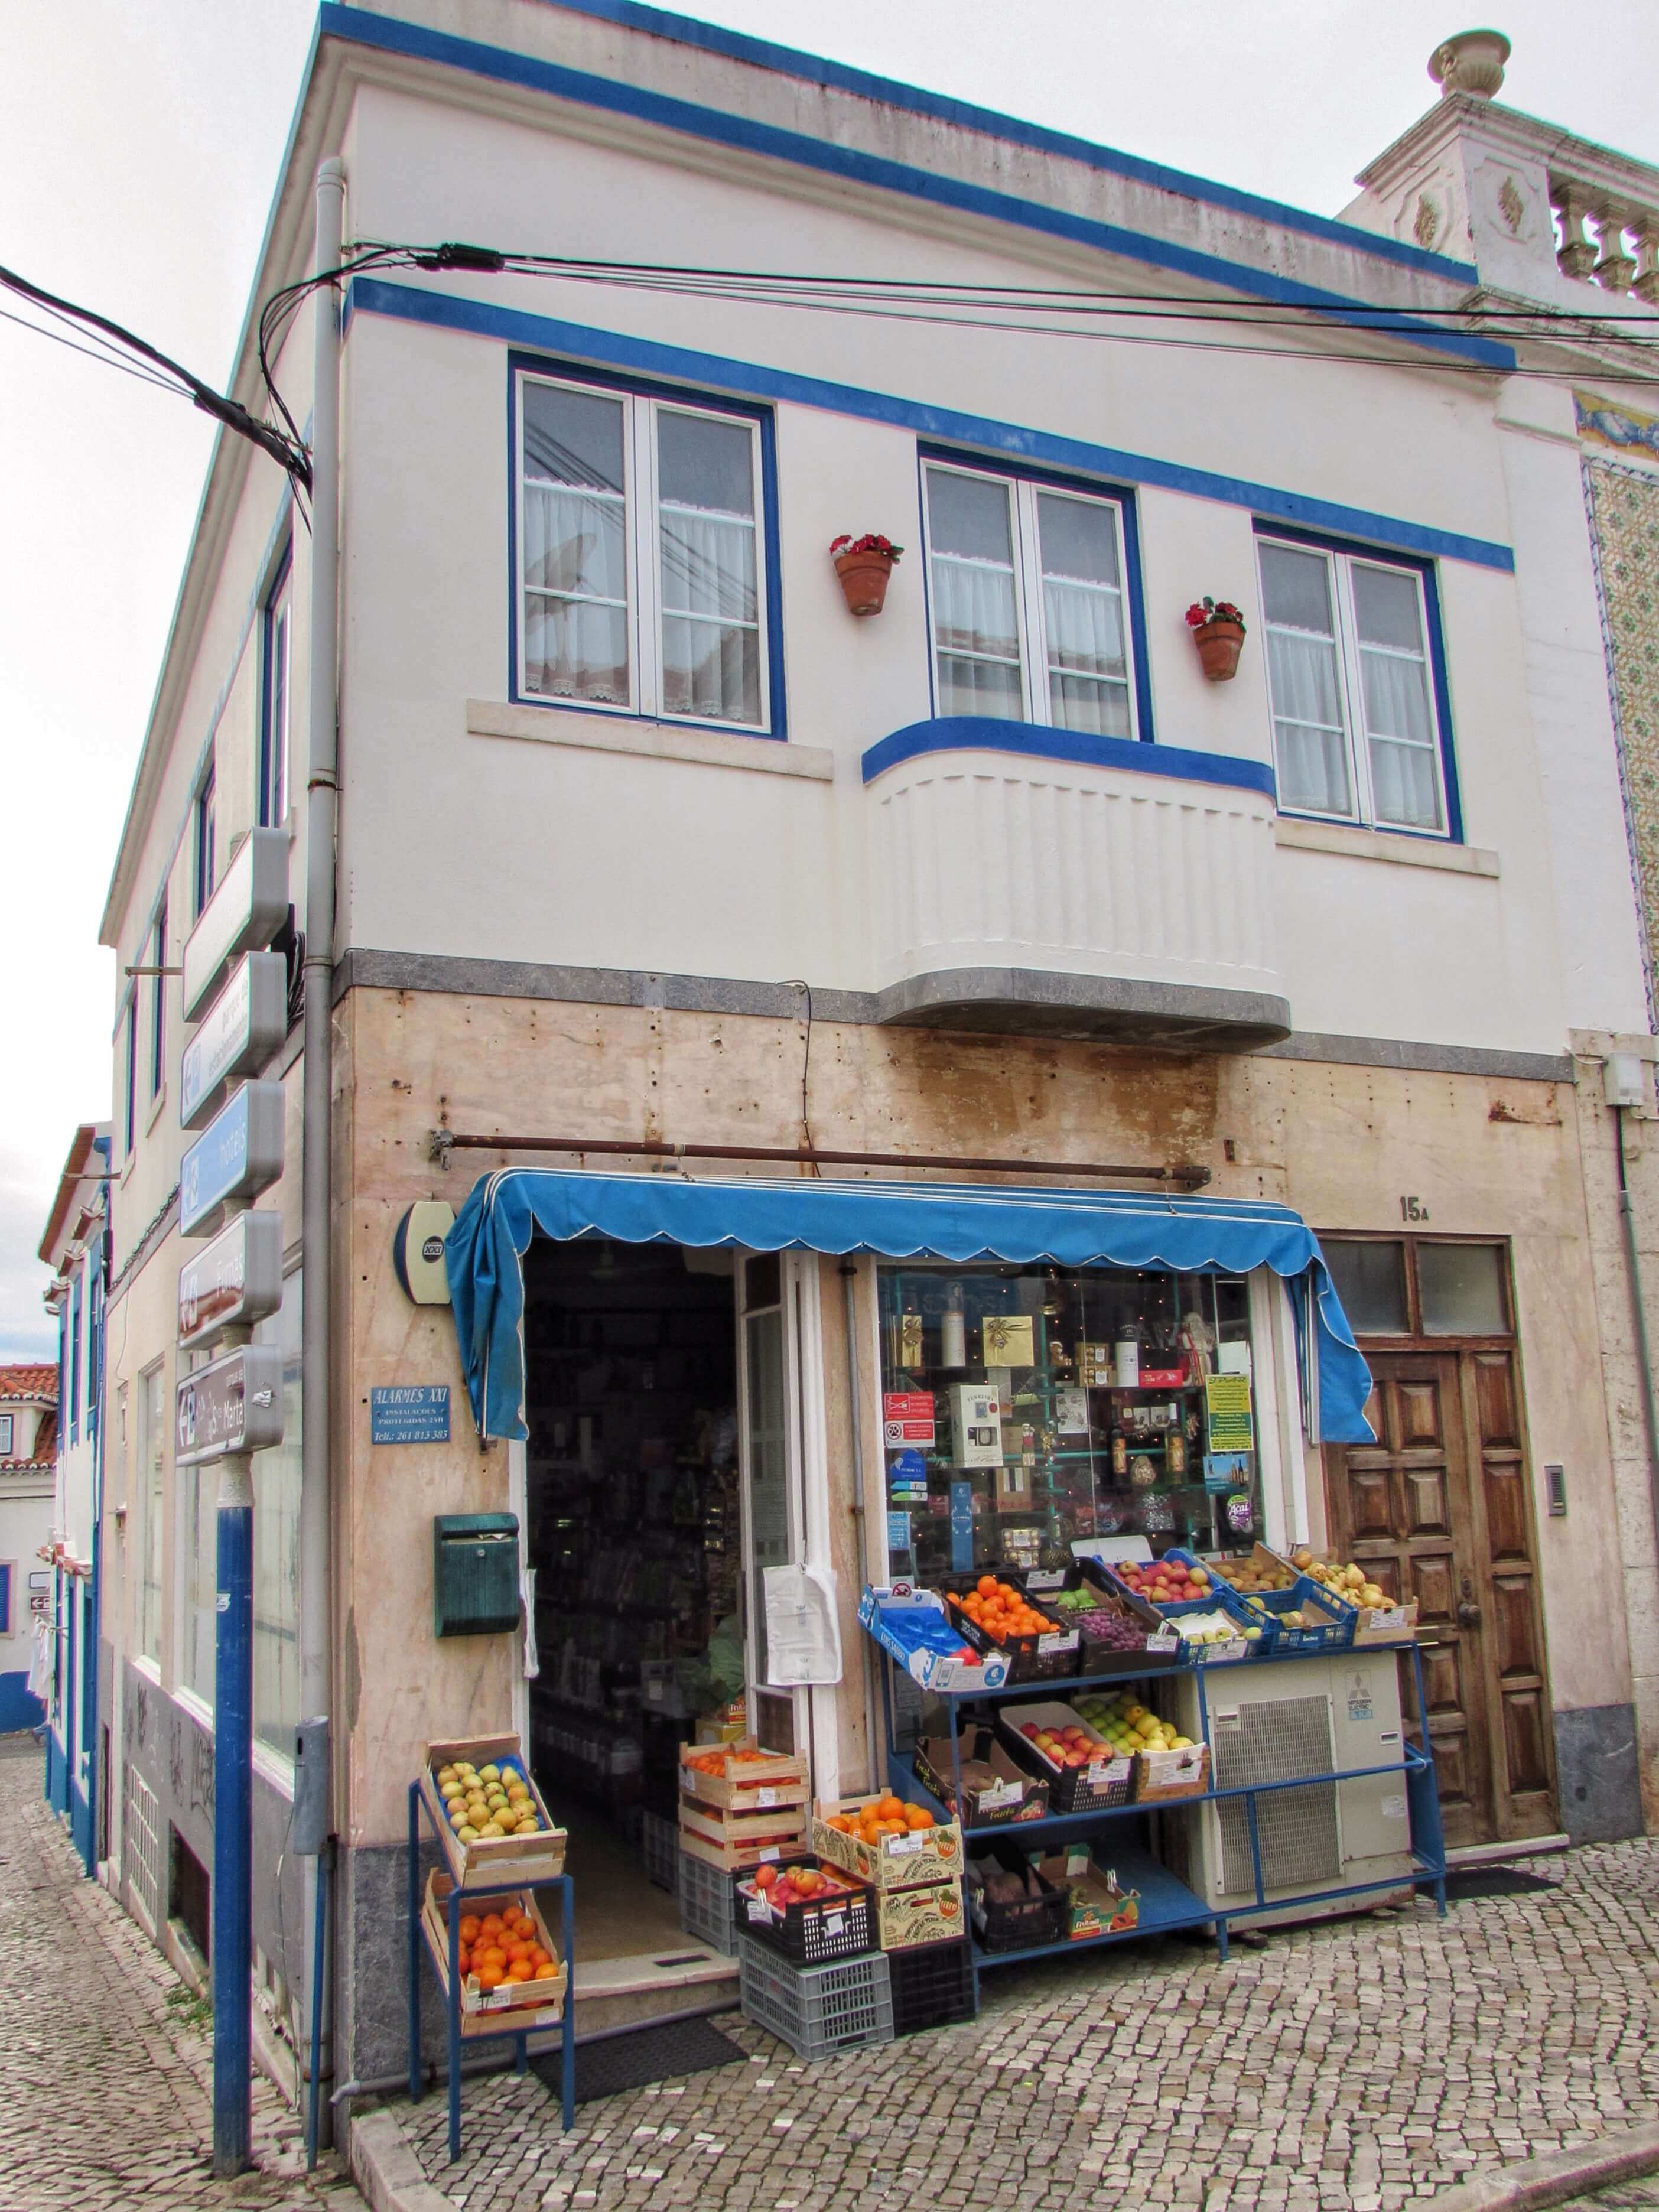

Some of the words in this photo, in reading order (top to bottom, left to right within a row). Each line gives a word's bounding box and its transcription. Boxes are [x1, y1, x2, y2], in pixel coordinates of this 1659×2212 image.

[220, 1115, 247, 1169] hotels
[1399, 1195, 1430, 1222] 15A
[373, 1388, 425, 1404] ALARMES
[429, 1387, 448, 1403] XXI
[223, 1395, 243, 1429] Marta
[396, 1431, 412, 1440] 261
